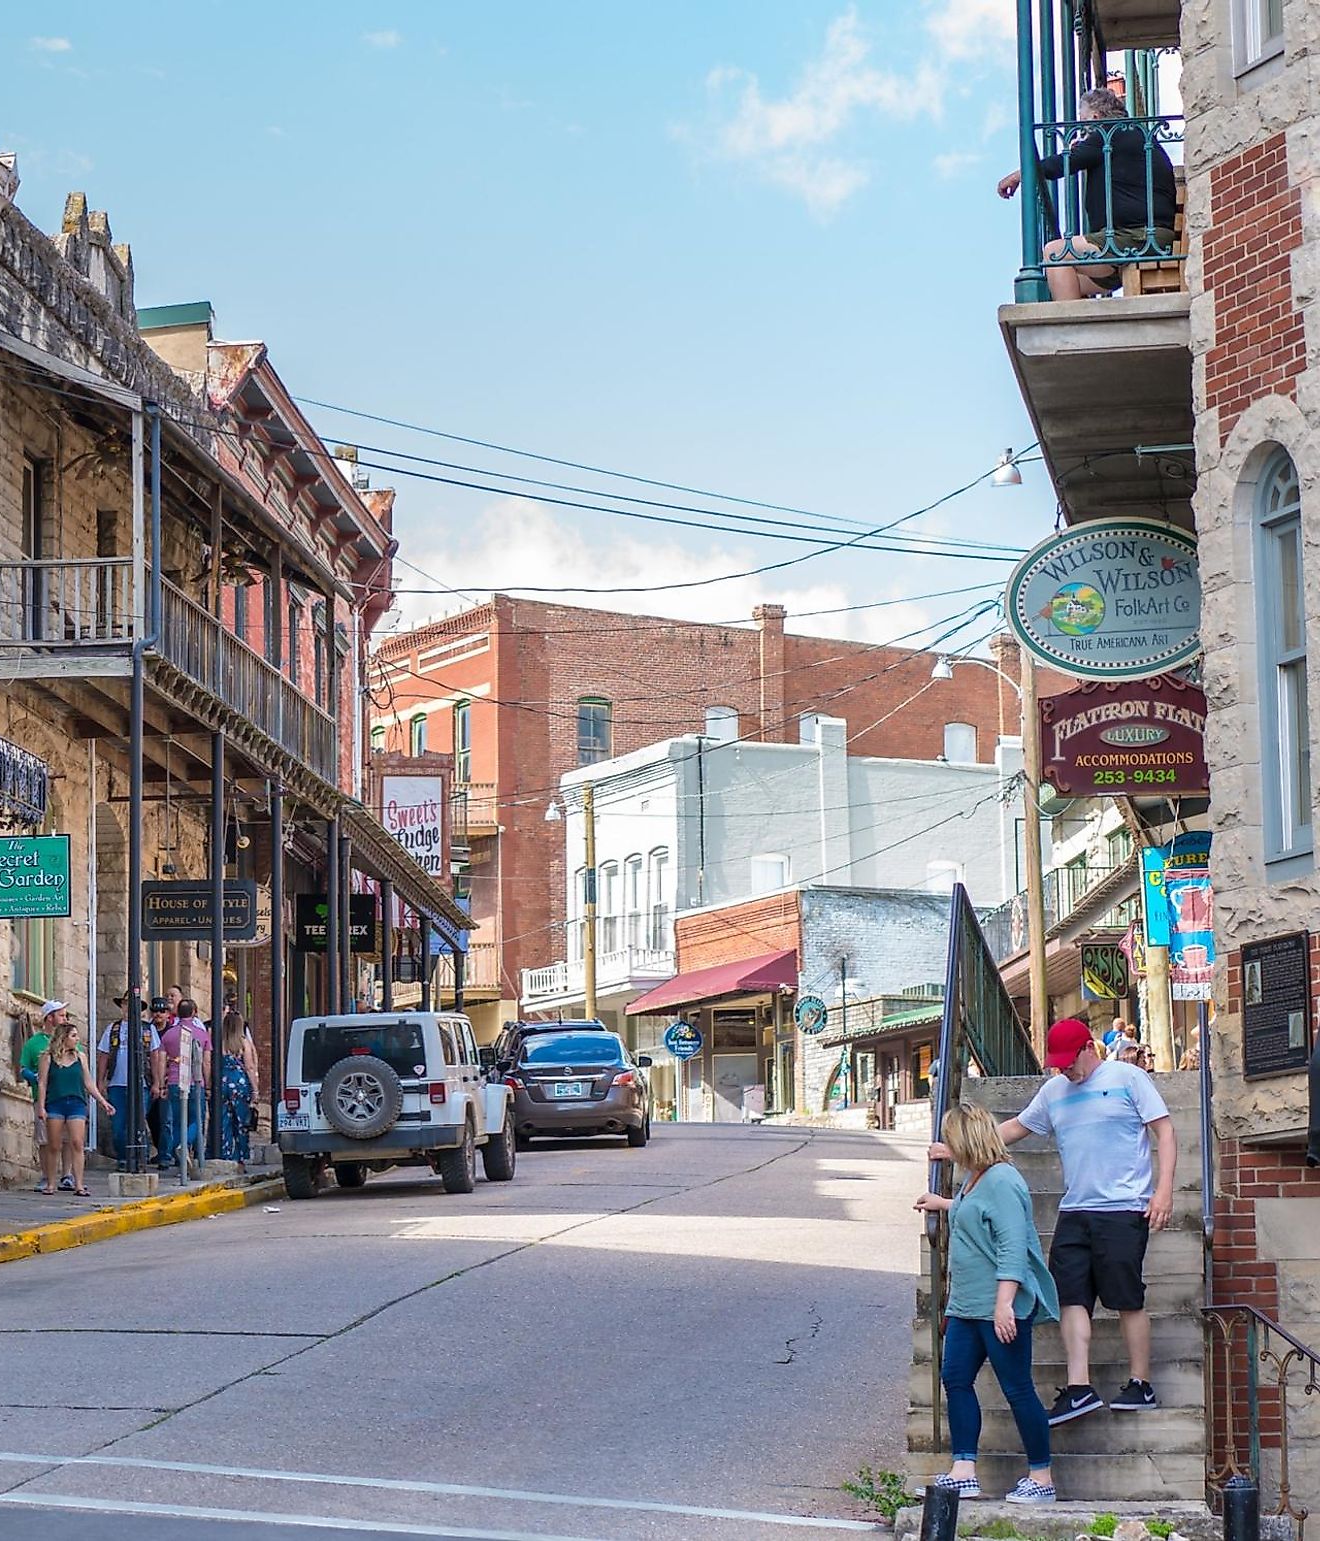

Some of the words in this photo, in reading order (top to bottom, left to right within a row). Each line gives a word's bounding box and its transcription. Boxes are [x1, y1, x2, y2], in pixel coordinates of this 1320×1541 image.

[1039, 540, 1137, 583] WILSON
[1138, 547, 1155, 567] &
[1093, 562, 1193, 595] WILSON
[1071, 638, 1094, 651] TRUE
[1096, 636, 1148, 648] AMERICANA
[1151, 634, 1169, 646] ART
[1051, 701, 1149, 761] FLATIRON
[1107, 728, 1165, 742] LUXURY
[1075, 752, 1195, 767] ACCOMMODATIONS
[1093, 769, 1176, 784] 253-9434
[388, 799, 438, 830] Sweet's
[8, 840, 25, 851] The
[410, 851, 441, 872] hen
[149, 897, 190, 910] HOUSE
[193, 900, 208, 909] OF
[152, 917, 191, 925] APPAREL
[304, 925, 327, 935] TEE
